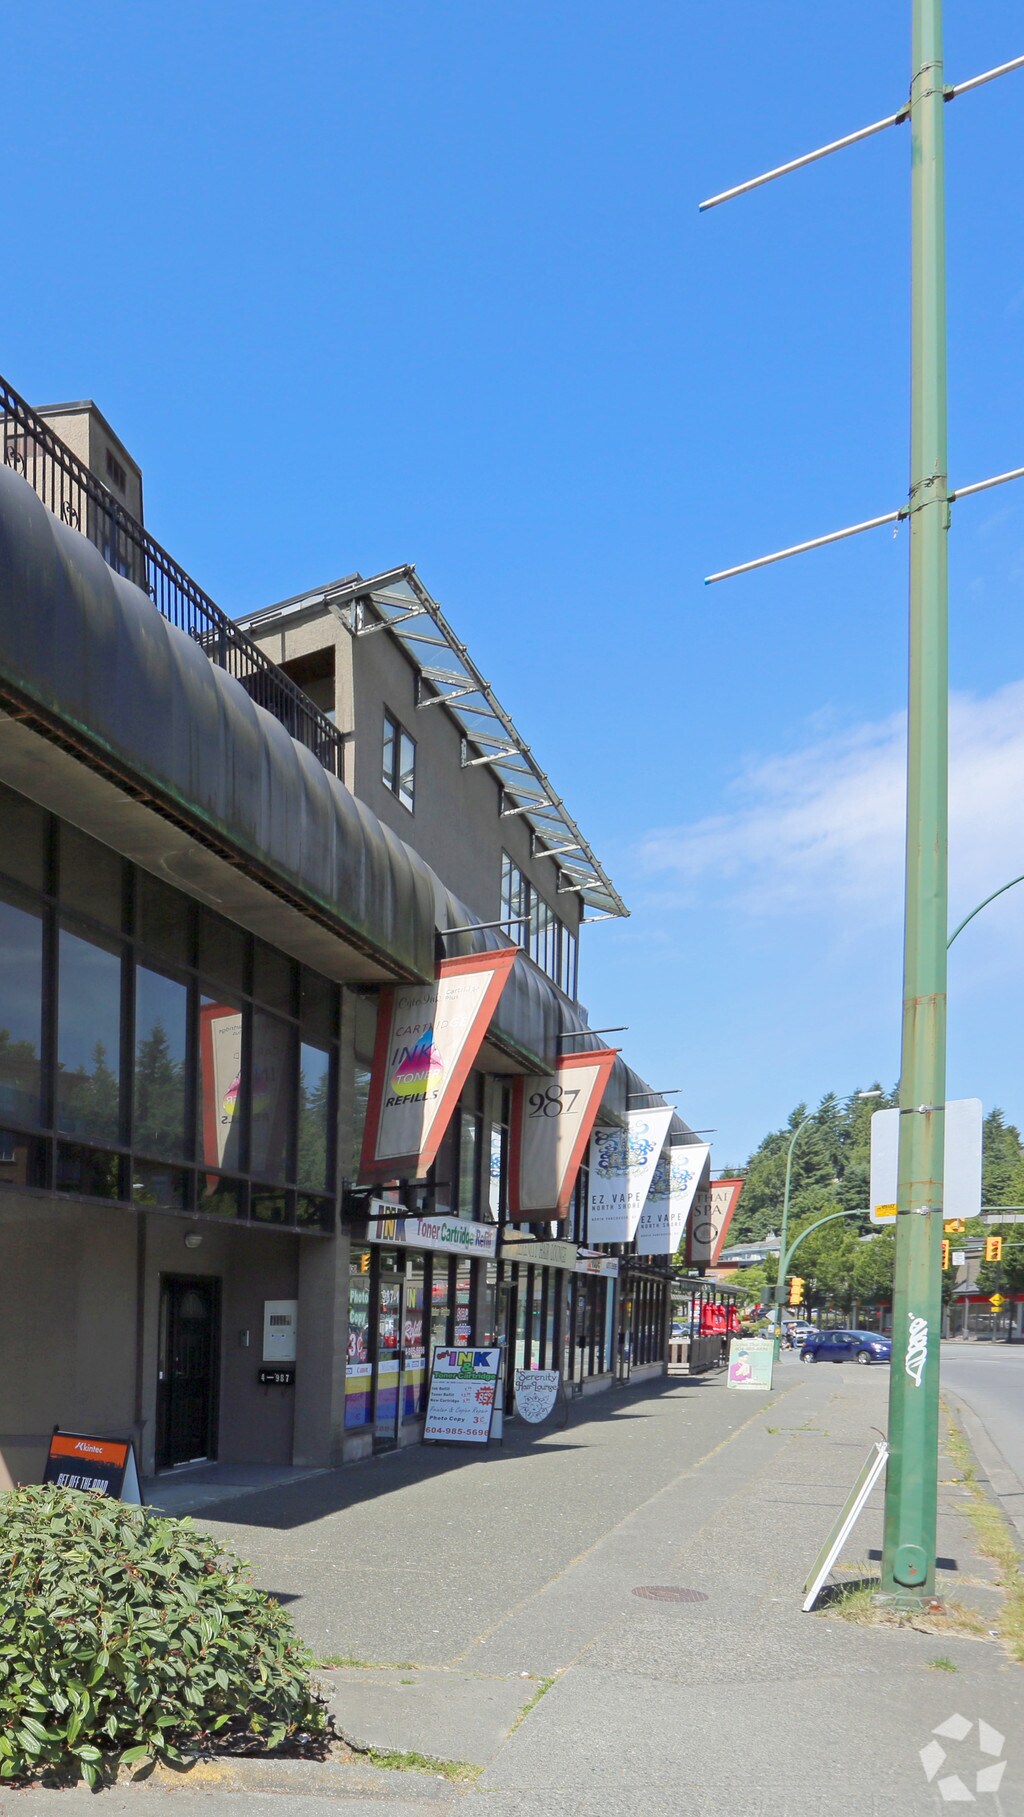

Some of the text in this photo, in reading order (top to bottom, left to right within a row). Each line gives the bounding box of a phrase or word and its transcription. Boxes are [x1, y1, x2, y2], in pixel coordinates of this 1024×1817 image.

[386, 1090, 439, 1107] REFILLS
[529, 1085, 581, 1118] 987
[592, 1192, 641, 1205] EZ VAPE
[696, 1192, 728, 1203] THAI
[694, 1204, 722, 1217] SPA
[641, 1213, 682, 1223] EZ VAPE
[376, 1204, 406, 1242] INK
[417, 1217, 440, 1239] Toner
[441, 1223, 474, 1250] Cartridge
[350, 1289, 369, 1304] Photo
[349, 1309, 367, 1328] Copy
[449, 1351, 492, 1367] INK
[460, 1362, 475, 1372] &
[434, 1371, 496, 1381] Toner Cartridge
[519, 1371, 557, 1382] Serenity
[83, 1443, 103, 1454] kintec
[69, 1475, 81, 1488] OFF
[80, 1476, 92, 1490] THE
